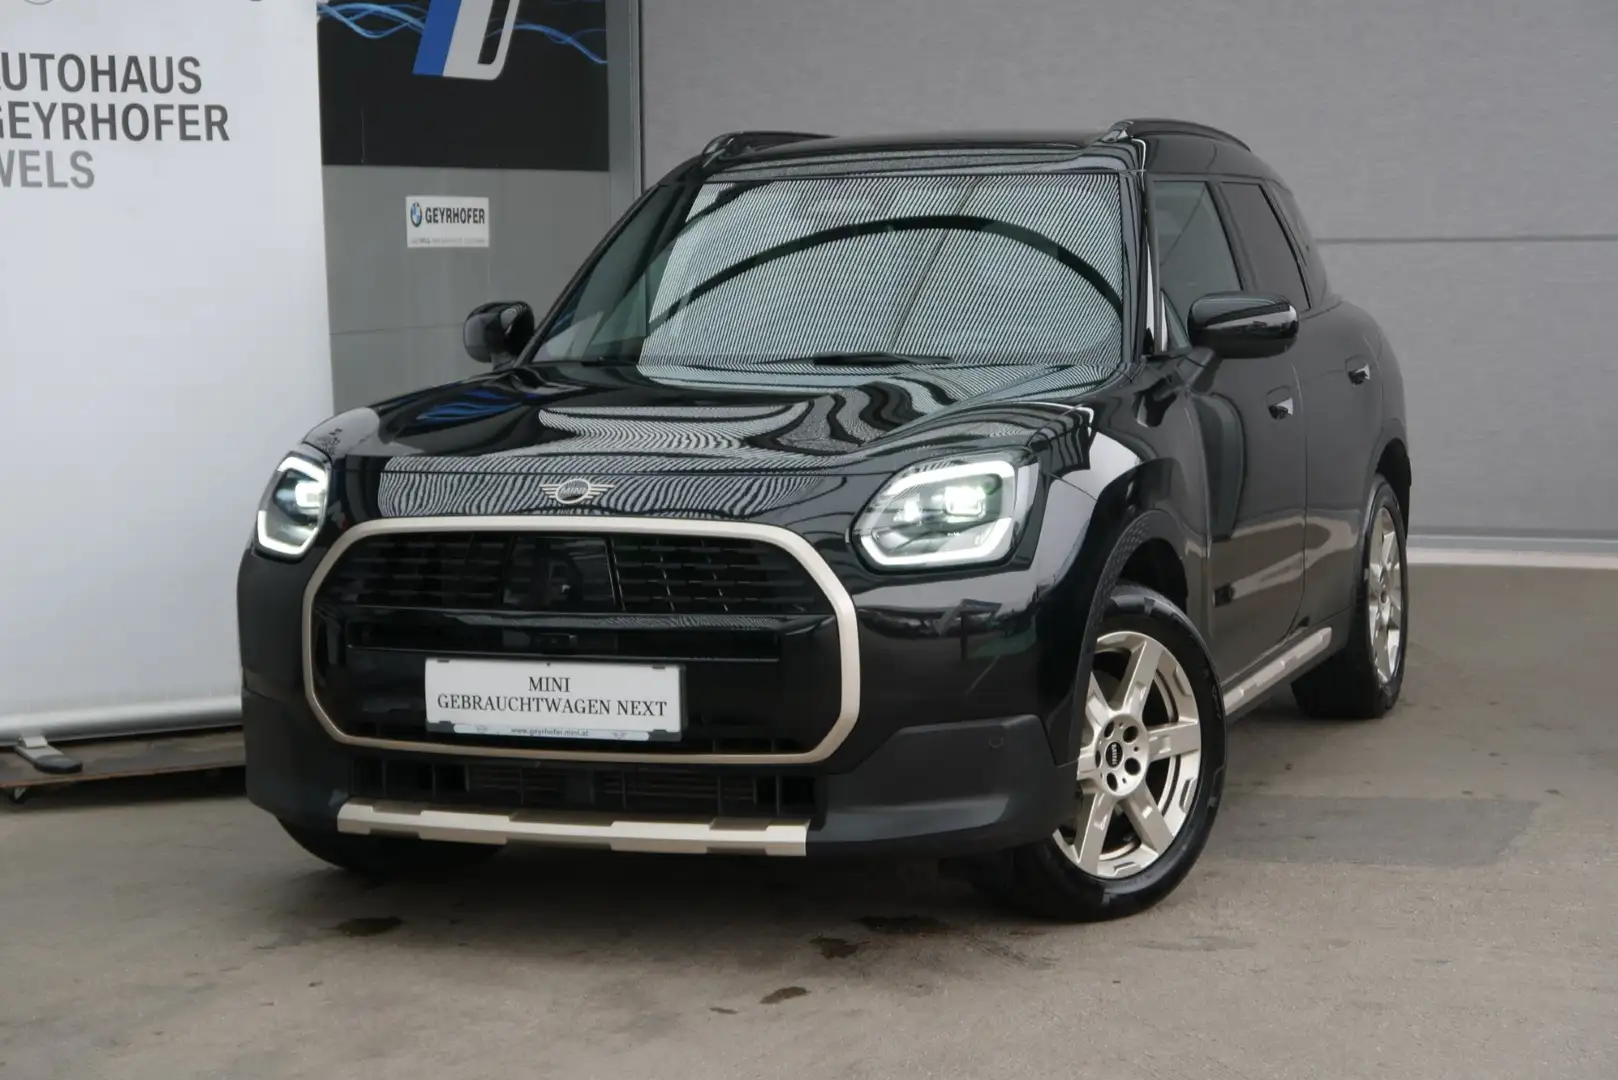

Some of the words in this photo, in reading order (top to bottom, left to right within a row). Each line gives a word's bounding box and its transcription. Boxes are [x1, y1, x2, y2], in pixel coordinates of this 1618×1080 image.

[0, 52, 202, 94] UTOHAUS
[0, 101, 230, 141] EYRHOFER
[425, 207, 485, 225] GEYRHOFER
[528, 676, 571, 693] MINI
[437, 693, 611, 715] GEBRAUCHTWAGEN
[616, 700, 668, 717] NEXT
